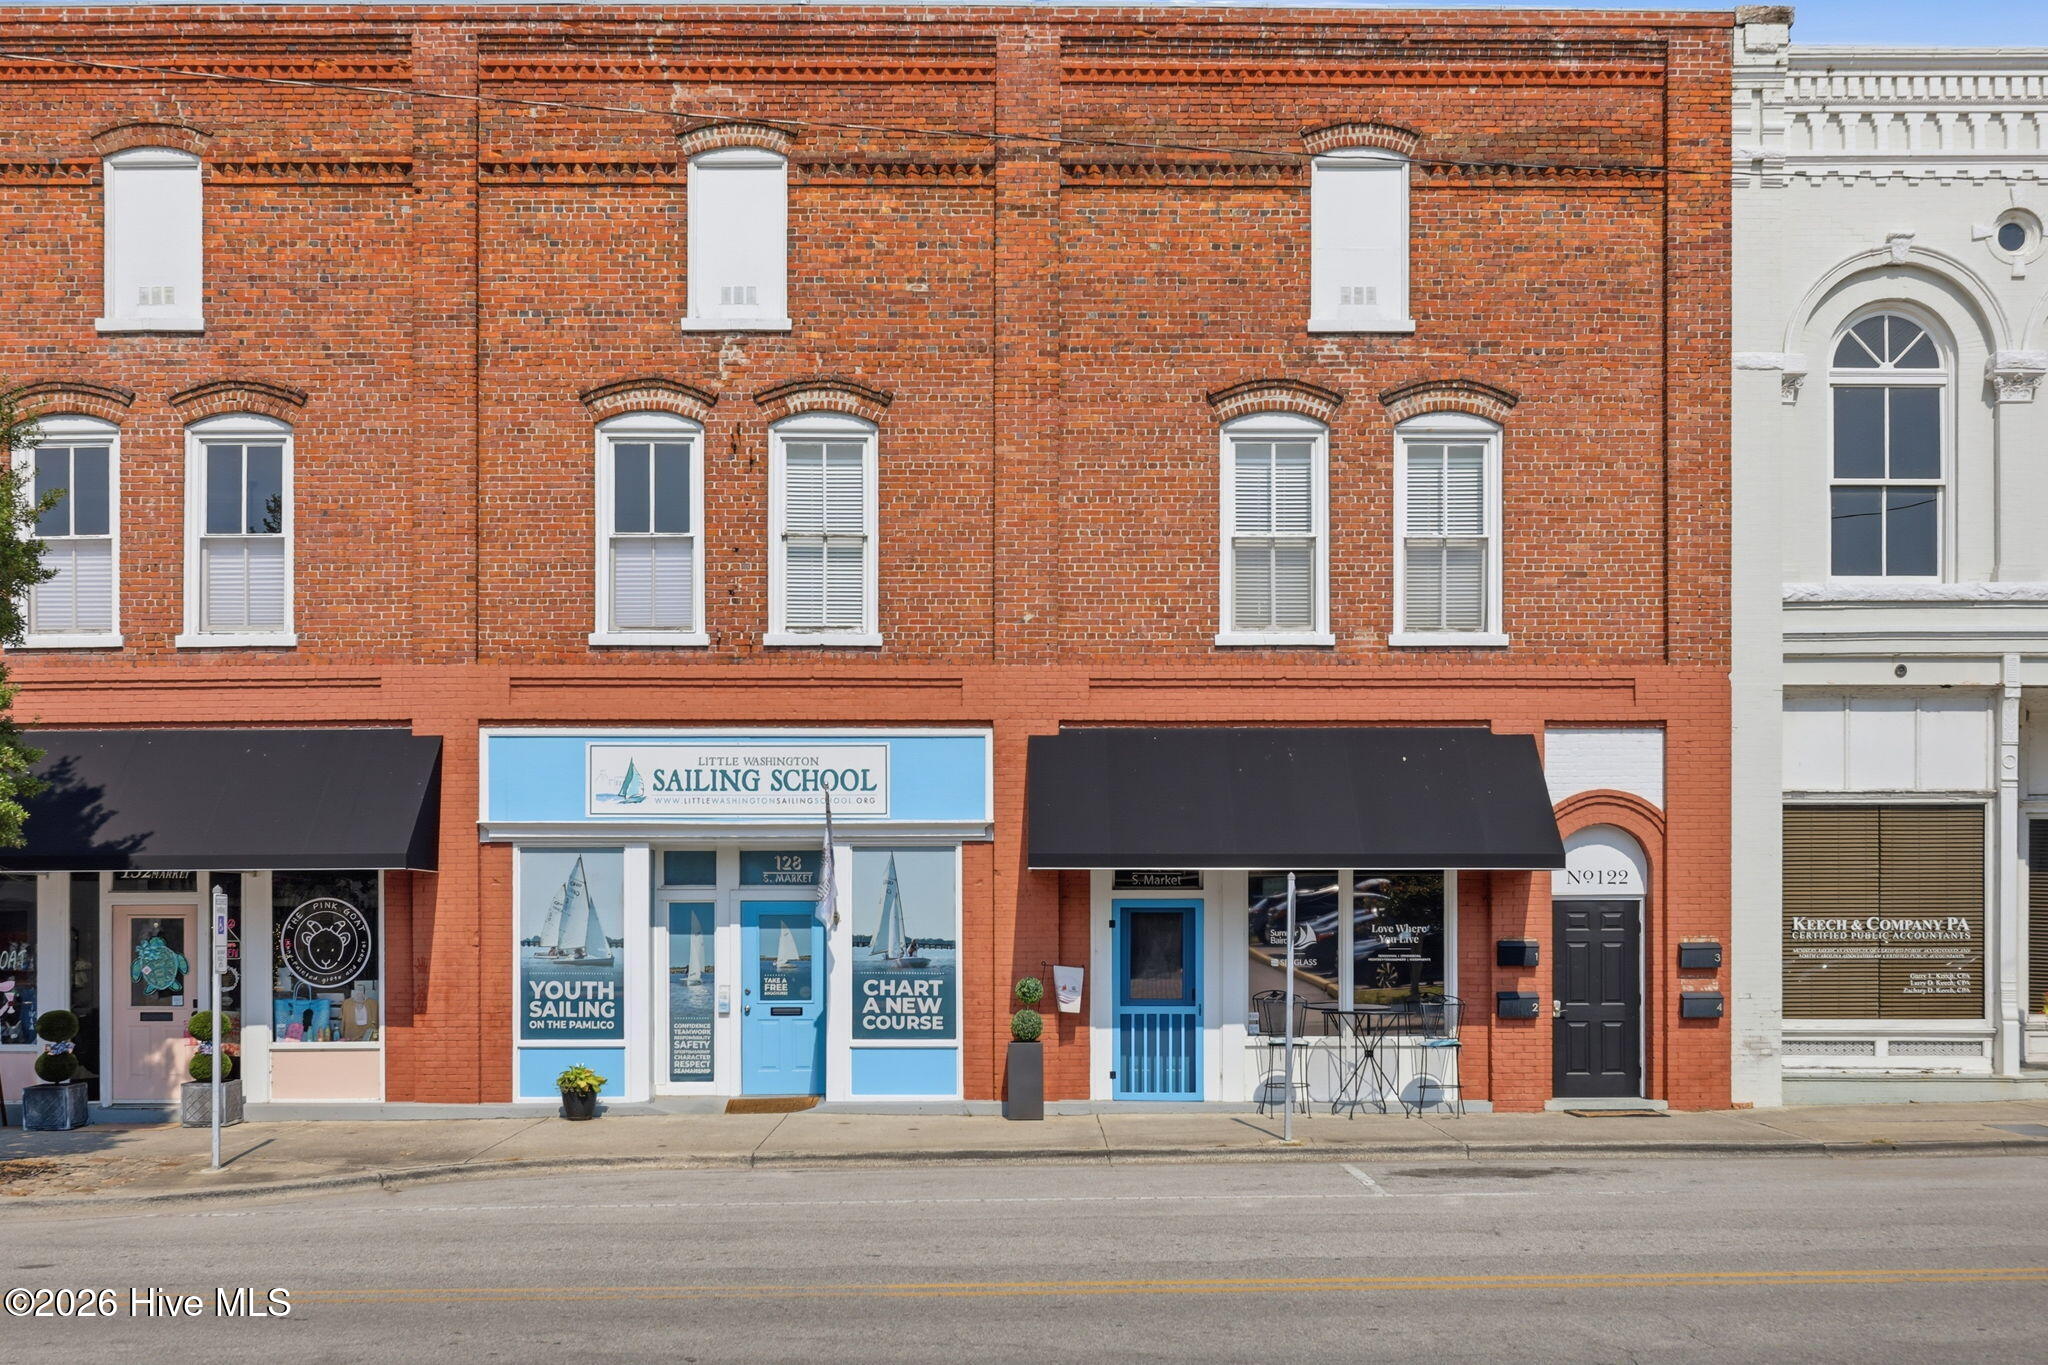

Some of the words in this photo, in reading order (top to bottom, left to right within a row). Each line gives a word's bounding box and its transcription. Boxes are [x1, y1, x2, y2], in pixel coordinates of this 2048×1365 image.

[698, 756, 739, 766] LITTLE
[743, 756, 819, 767] WASHINGTON
[652, 768, 760, 792] SAILING
[770, 768, 878, 792] SCHOOL
[655, 796, 876, 805] WWW.LITTLEWASHINGTONSAILINGSCOOL.ORG
[774, 855, 802, 871] 128
[763, 874, 772, 883] S.
[775, 874, 813, 884] MARKET
[1132, 874, 1141, 885] S.
[1144, 874, 1181, 885] Market
[287, 911, 304, 931] THE
[312, 901, 339, 910] PINK
[343, 908, 366, 932] GOAT
[1371, 924, 1394, 933] Love
[1395, 923, 1427, 933] Where
[1792, 916, 1847, 931] KEECH
[1850, 919, 1862, 931] &
[1866, 916, 1942, 931] COMPANY
[1947, 916, 1970, 931] PA
[1379, 934, 1397, 944] You
[1399, 934, 1420, 944] Live
[1792, 931, 1848, 940] CERTIFIED
[1851, 931, 1889, 940] PUBLIC
[1892, 931, 1971, 940] ACCOUNTANTS
[1534, 952, 1539, 960] 1
[1714, 953, 1721, 962] 3
[529, 981, 614, 1000] YOUTH
[863, 979, 943, 996] CHART
[529, 1001, 615, 1018] SAILING
[862, 997, 880, 1013] A
[885, 997, 942, 1014] NEW
[1531, 1003, 1539, 1012] 2
[1716, 1003, 1722, 1011] 4
[529, 1020, 545, 1029] ON
[547, 1020, 567, 1029] THE
[569, 1020, 614, 1029] PAMLICO
[862, 1015, 944, 1030] COURSE
[673, 1041, 711, 1049] SAFETY
